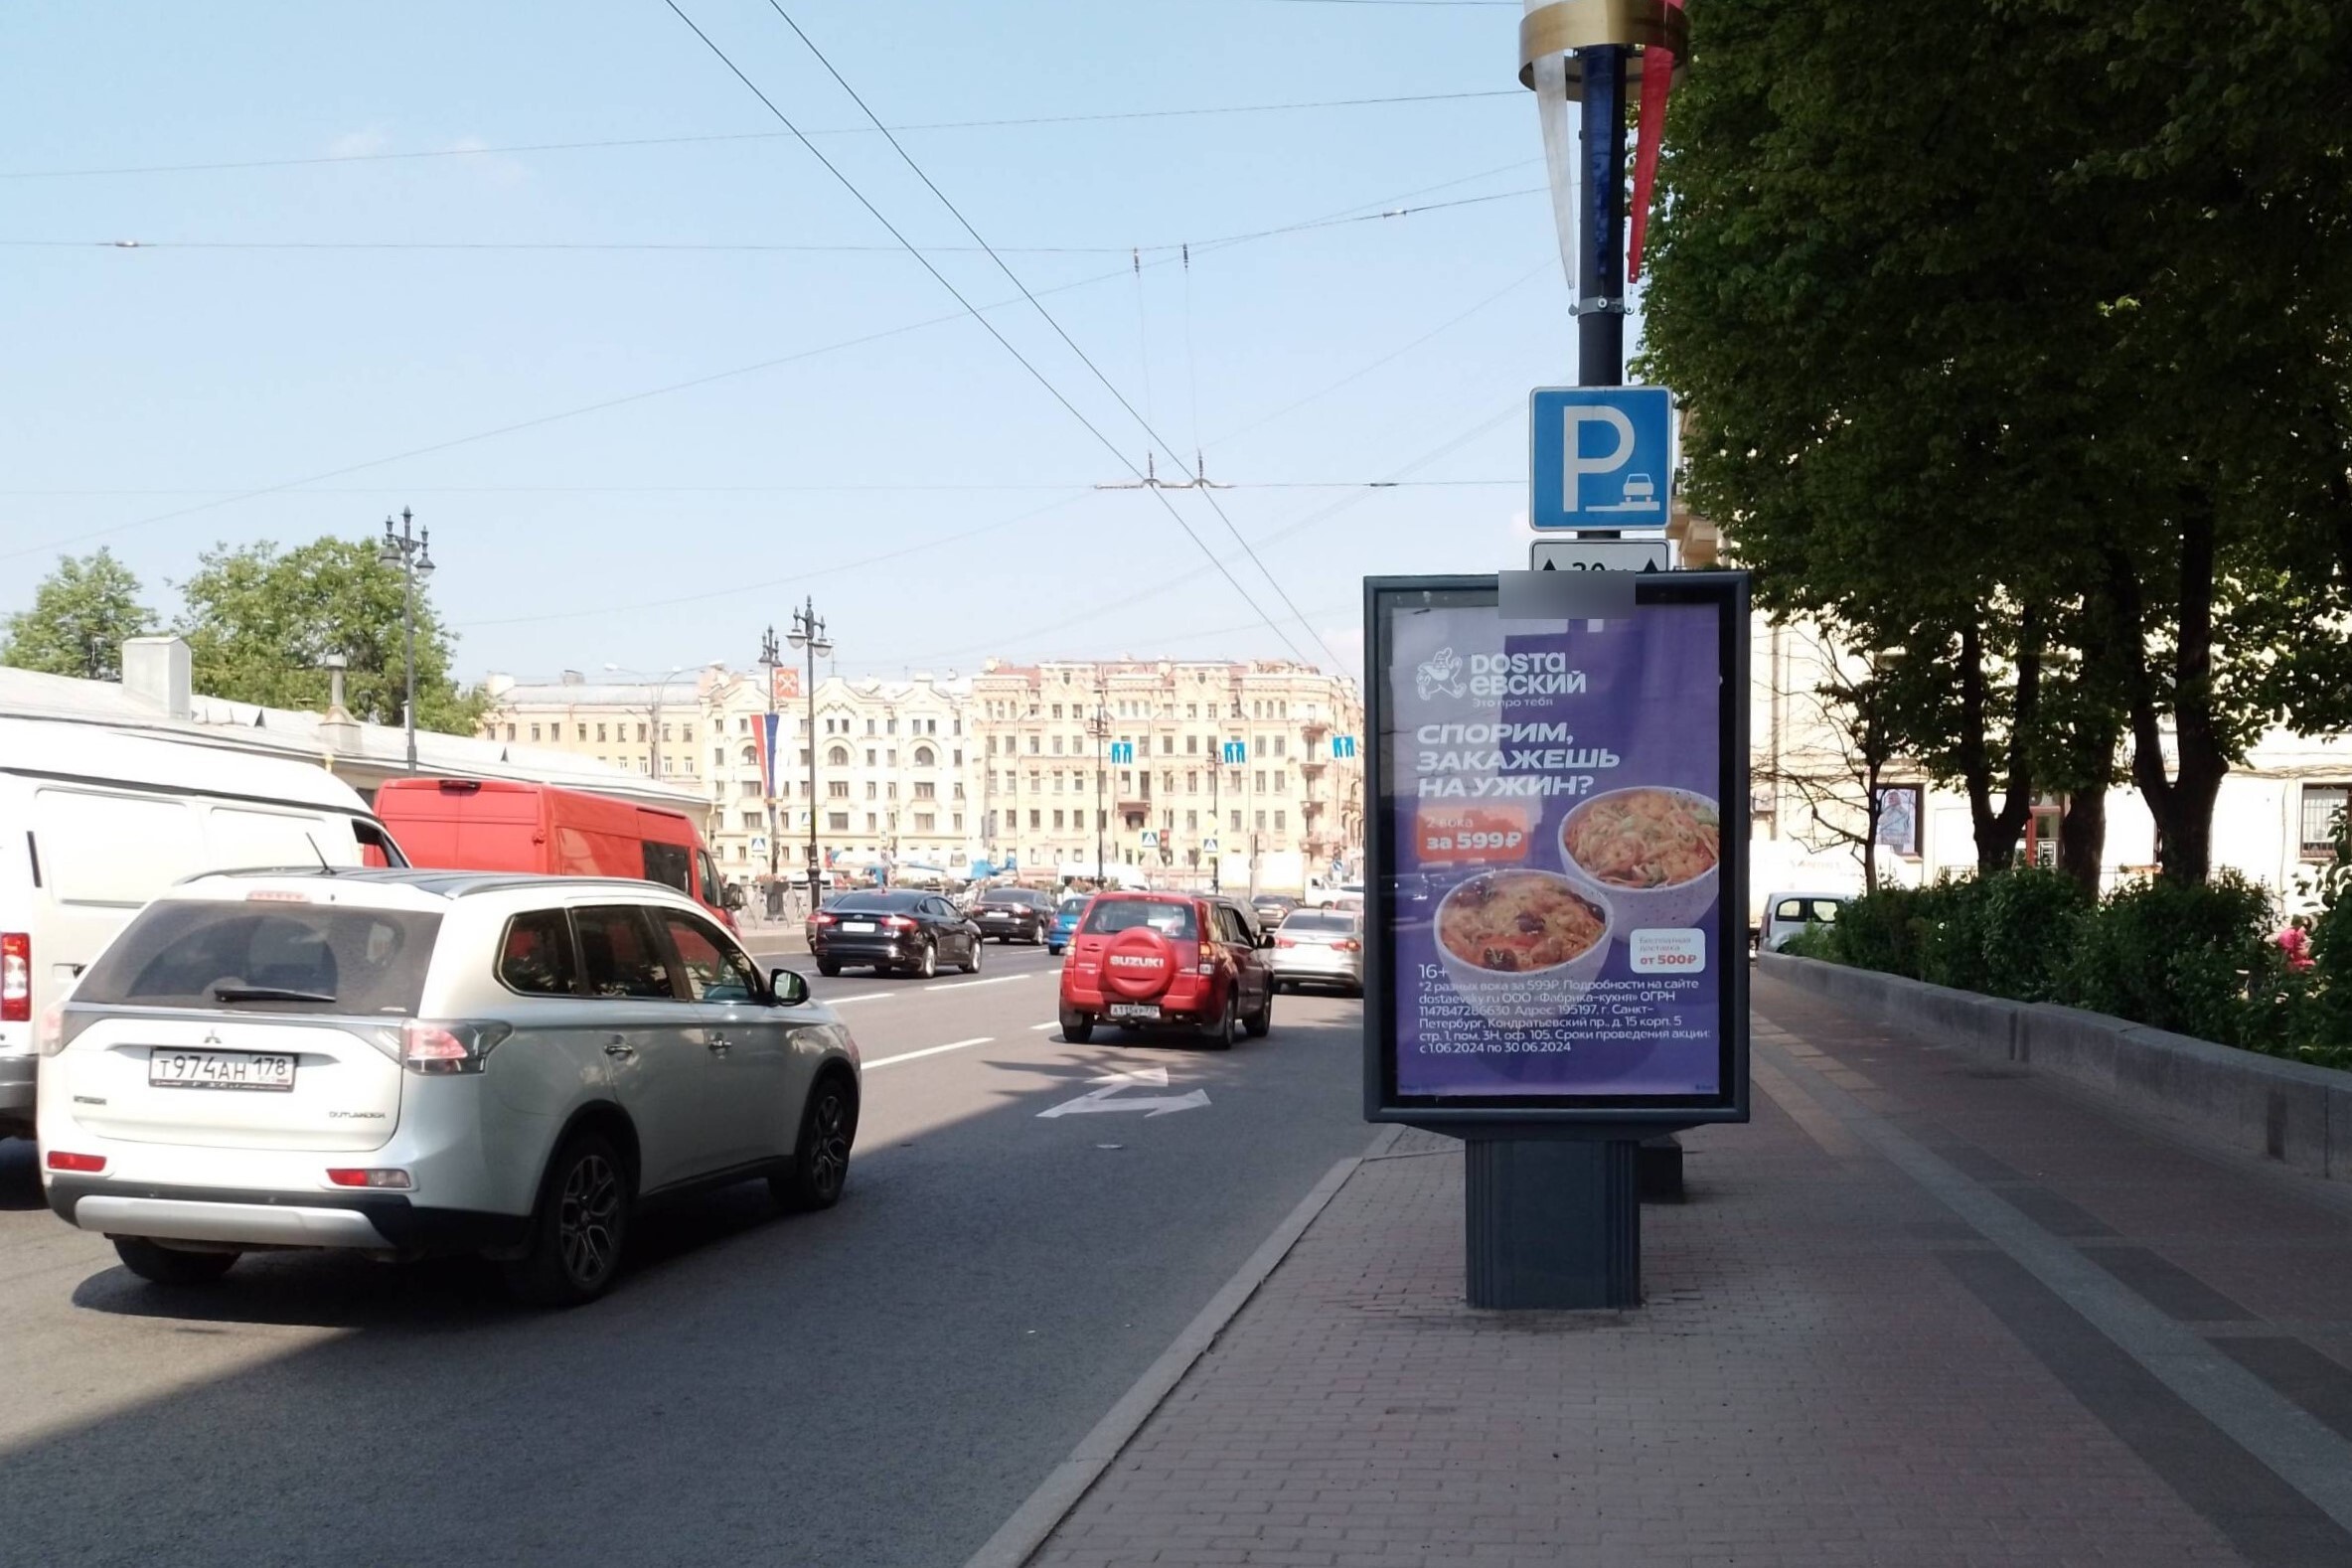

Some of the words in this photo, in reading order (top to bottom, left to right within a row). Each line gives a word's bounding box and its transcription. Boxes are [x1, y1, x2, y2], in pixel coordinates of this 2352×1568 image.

[1563, 404, 1636, 513] P
[1472, 698, 1496, 708] Это
[1497, 699, 1522, 709] про
[1524, 697, 1554, 707] тебя
[1416, 722, 1575, 745] СПОРИМ,
[1416, 747, 1621, 772] ЗАКАЖЕШЬ
[1417, 776, 1468, 798] НА
[1471, 774, 1595, 798] УЖИН?
[1426, 816, 1437, 829] 2
[1438, 818, 1474, 829] вока
[1426, 836, 1453, 851] за
[1456, 830, 1522, 850] 599₽
[1109, 955, 1165, 969] SUZUKI
[1640, 957, 1655, 966] от
[1418, 963, 1449, 979] 16+
[1480, 982, 1508, 992] вока
[1509, 982, 1525, 992] за
[1563, 980, 1646, 992] Подробности
[1646, 981, 1663, 990] на
[1664, 979, 1700, 989] сайте
[1418, 994, 1500, 1007] dostaevsky.ru
[1501, 993, 1532, 1004] ООО
[1640, 991, 1676, 1003] ОГРН
[1611, 1004, 1654, 1015] Санкт-
[1488, 1017, 1588, 1030] Кондратьевский
[1625, 1016, 1638, 1026] 15
[1639, 1018, 1672, 1029] корп.
[1672, 1015, 1682, 1026] 5
[1419, 1031, 1442, 1042] стр.
[1453, 1031, 1481, 1041] пом.
[1554, 1029, 1594, 1041] Сроки
[1595, 1029, 1670, 1041] проведения
[1671, 1029, 1711, 1040] акции:
[1419, 1045, 1428, 1054] с
[1487, 1043, 1502, 1054] по
[252, 1055, 287, 1076] 178
